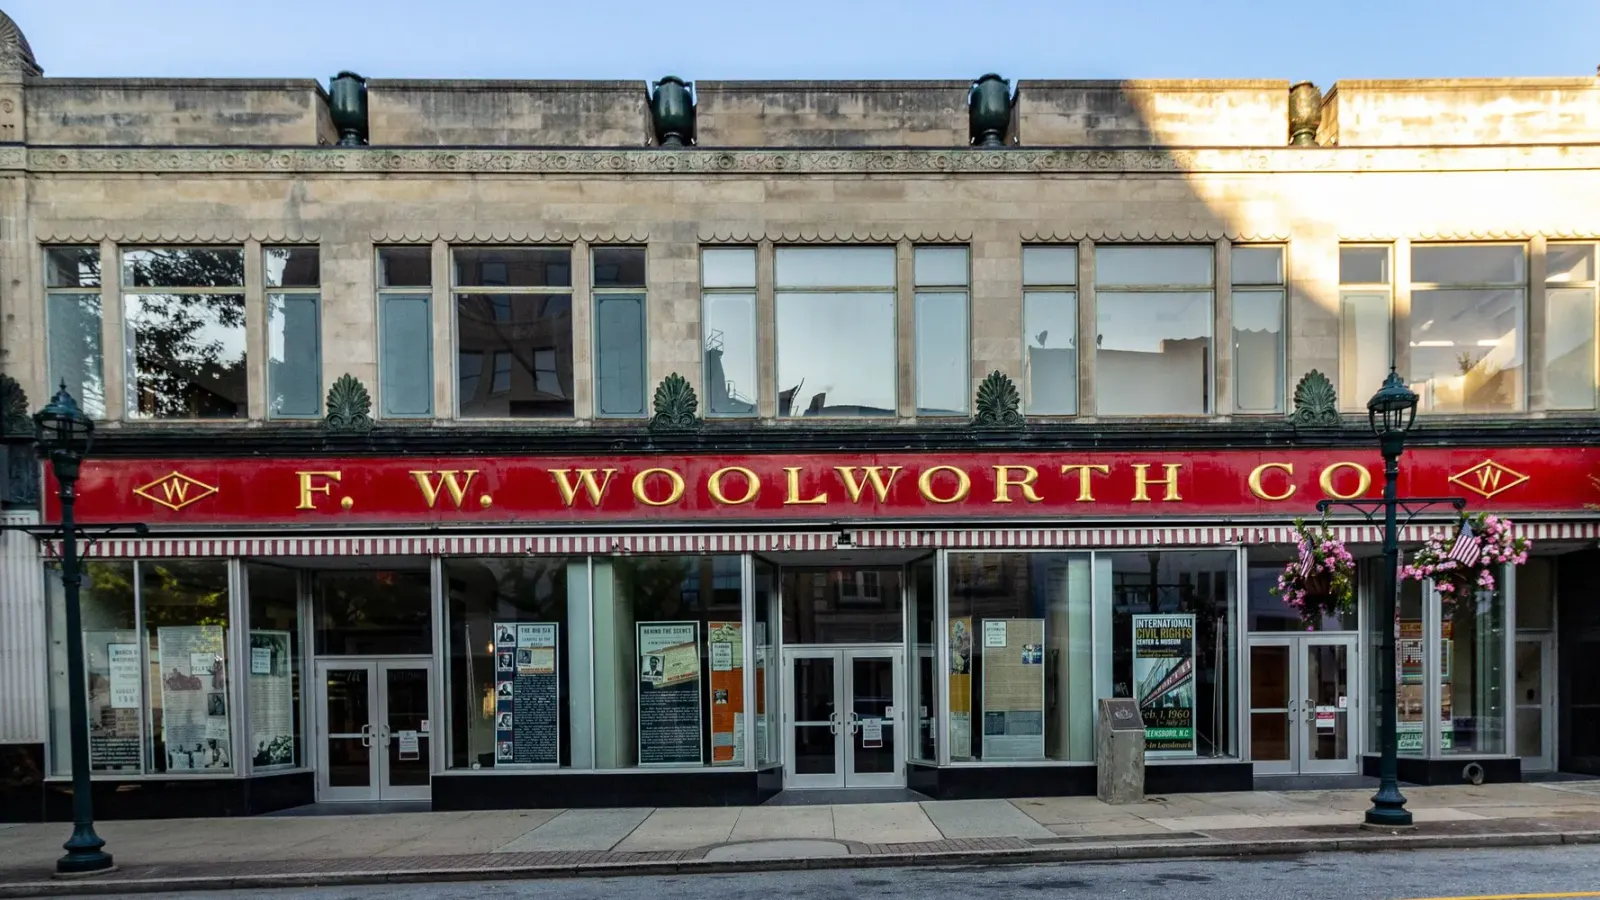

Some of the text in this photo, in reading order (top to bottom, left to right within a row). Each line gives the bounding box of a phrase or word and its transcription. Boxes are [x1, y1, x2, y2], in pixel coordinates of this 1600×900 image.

[1477, 466, 1502, 491] W
[160, 476, 190, 503] W
[297, 462, 1384, 510] F. W. WOOLWORTH CO
[1137, 619, 1192, 628] INTERNATIONAL
[1137, 628, 1192, 639] CIVIL RIGHTS
[1169, 709, 1190, 719] 1960
[1158, 741, 1193, 749] Landmark
